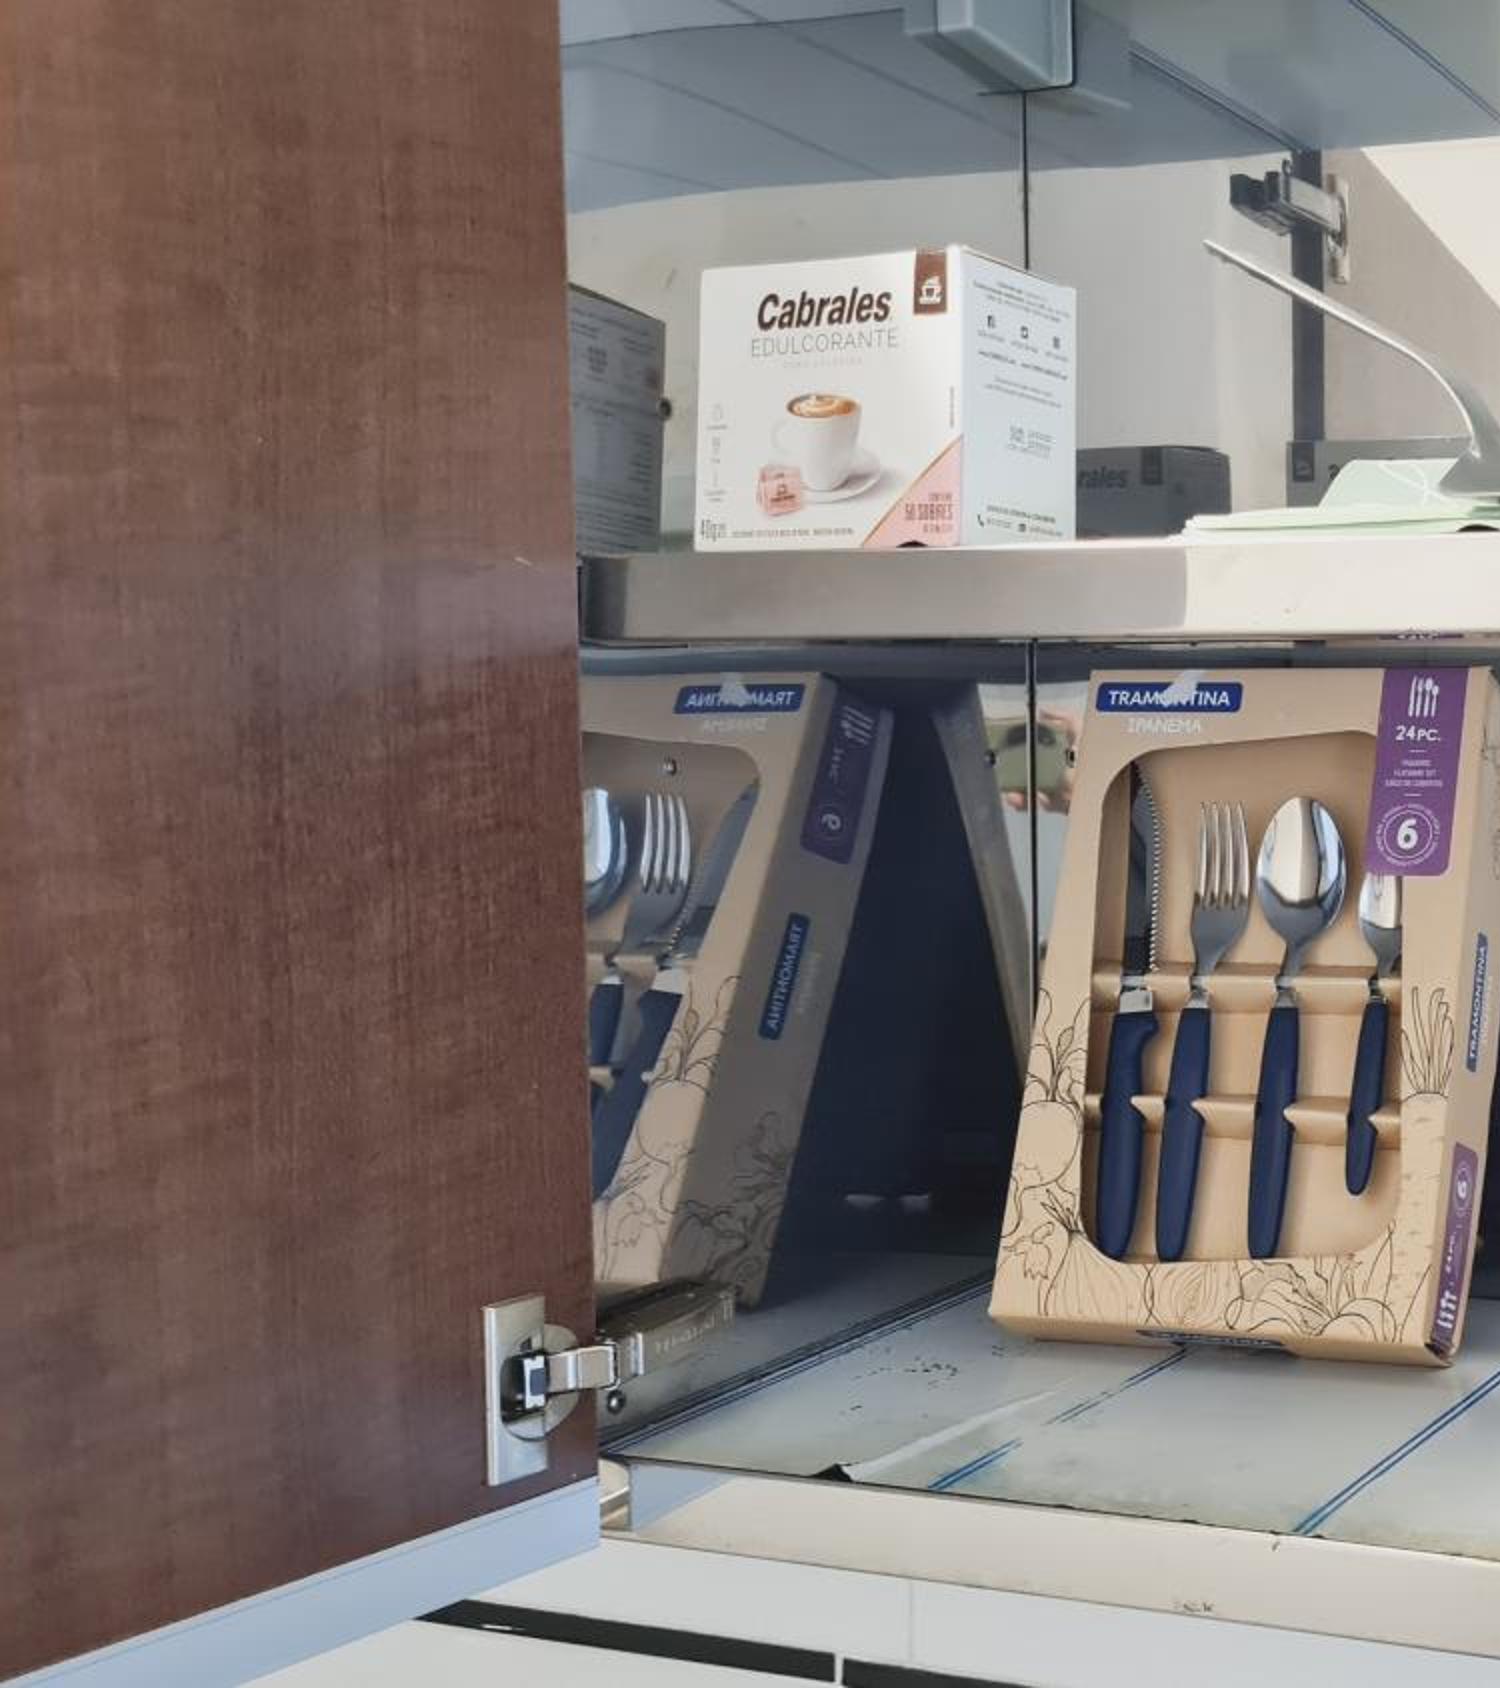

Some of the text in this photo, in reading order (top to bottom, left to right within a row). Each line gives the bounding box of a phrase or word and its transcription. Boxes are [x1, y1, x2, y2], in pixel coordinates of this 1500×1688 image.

[757, 286, 892, 331] Cabrales
[752, 327, 899, 357] EDULCORANTE
[1397, 818, 1418, 850] 6
[1469, 946, 1488, 1057] TRAMONTINA
